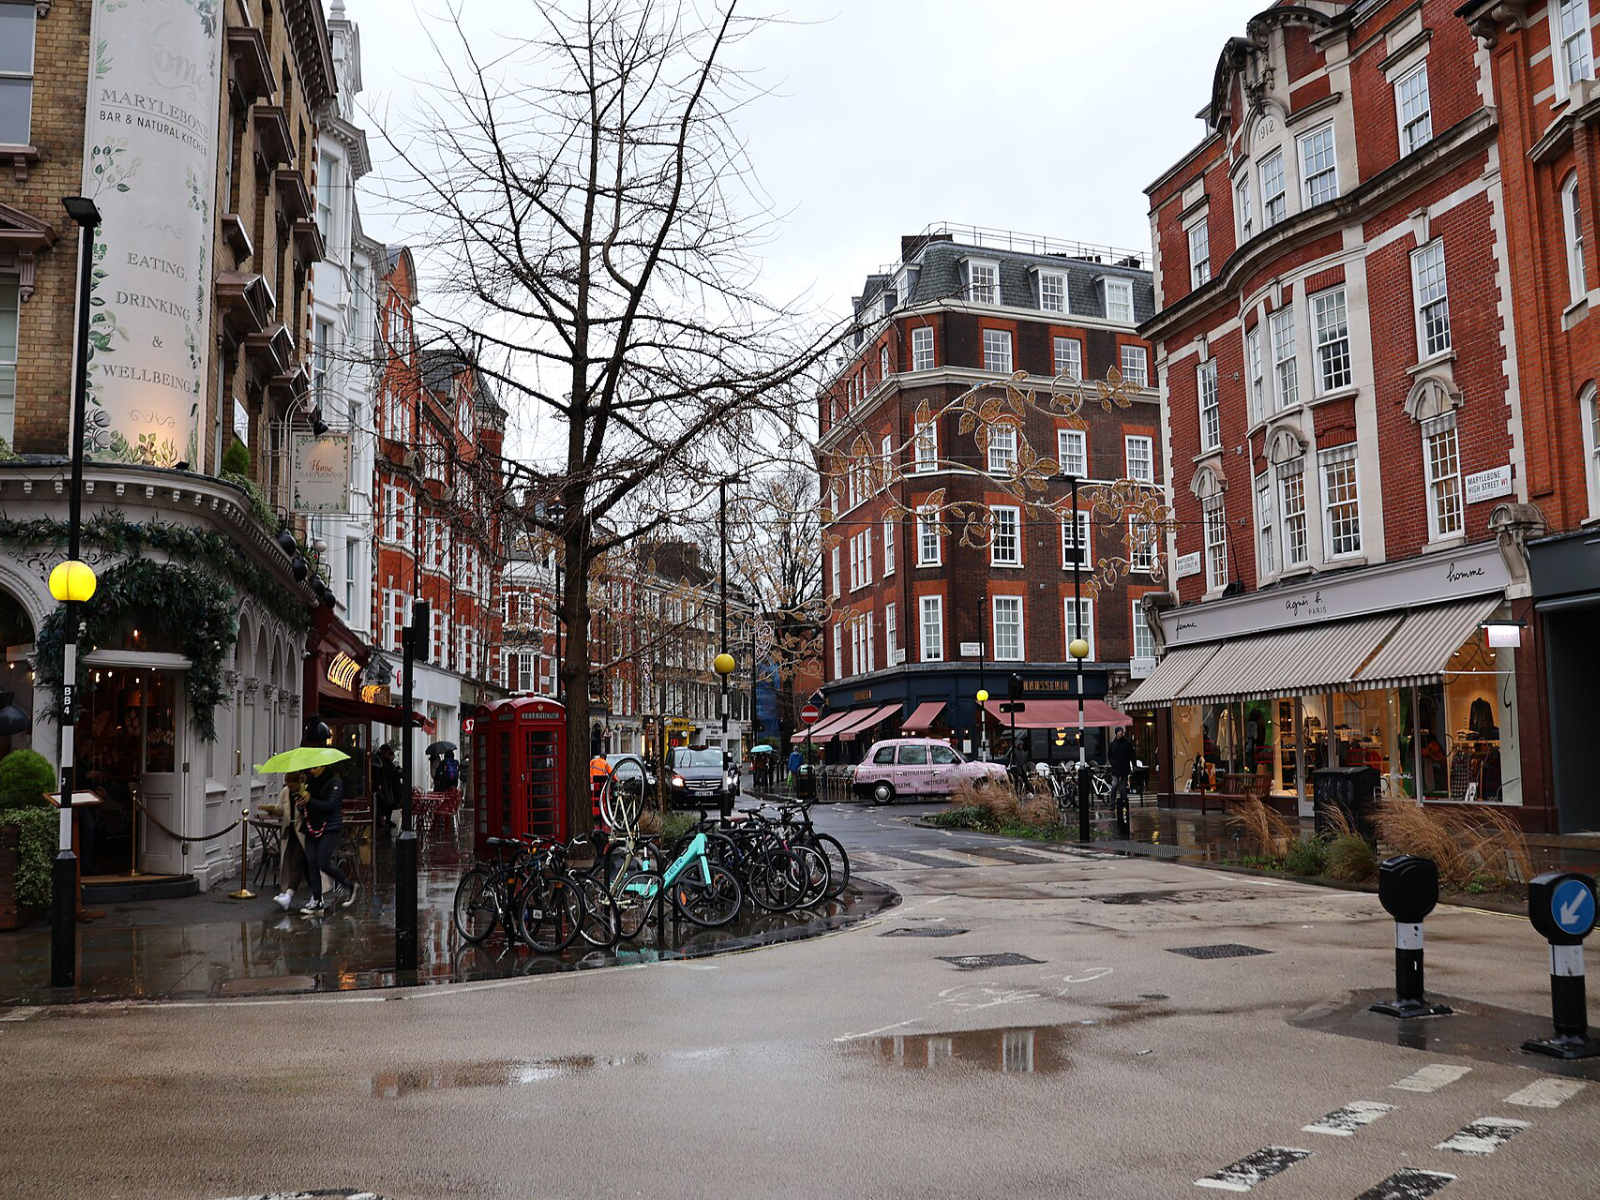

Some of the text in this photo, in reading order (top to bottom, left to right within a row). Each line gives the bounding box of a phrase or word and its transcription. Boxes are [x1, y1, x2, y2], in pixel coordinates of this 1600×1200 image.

[101, 89, 209, 140] MARYLEBONE
[99, 110, 207, 157] BAR & NATURAL KITCHEN
[1257, 119, 1275, 142] 1912
[127, 252, 188, 282] EATING,
[115, 290, 191, 321] DRINKING
[152, 335, 163, 348] &
[1468, 471, 1501, 485] MARYLEBONE
[1468, 478, 1508, 494] HIGH STREET W1
[1446, 563, 1485, 582] homme
[1308, 606, 1327, 616] PARIS
